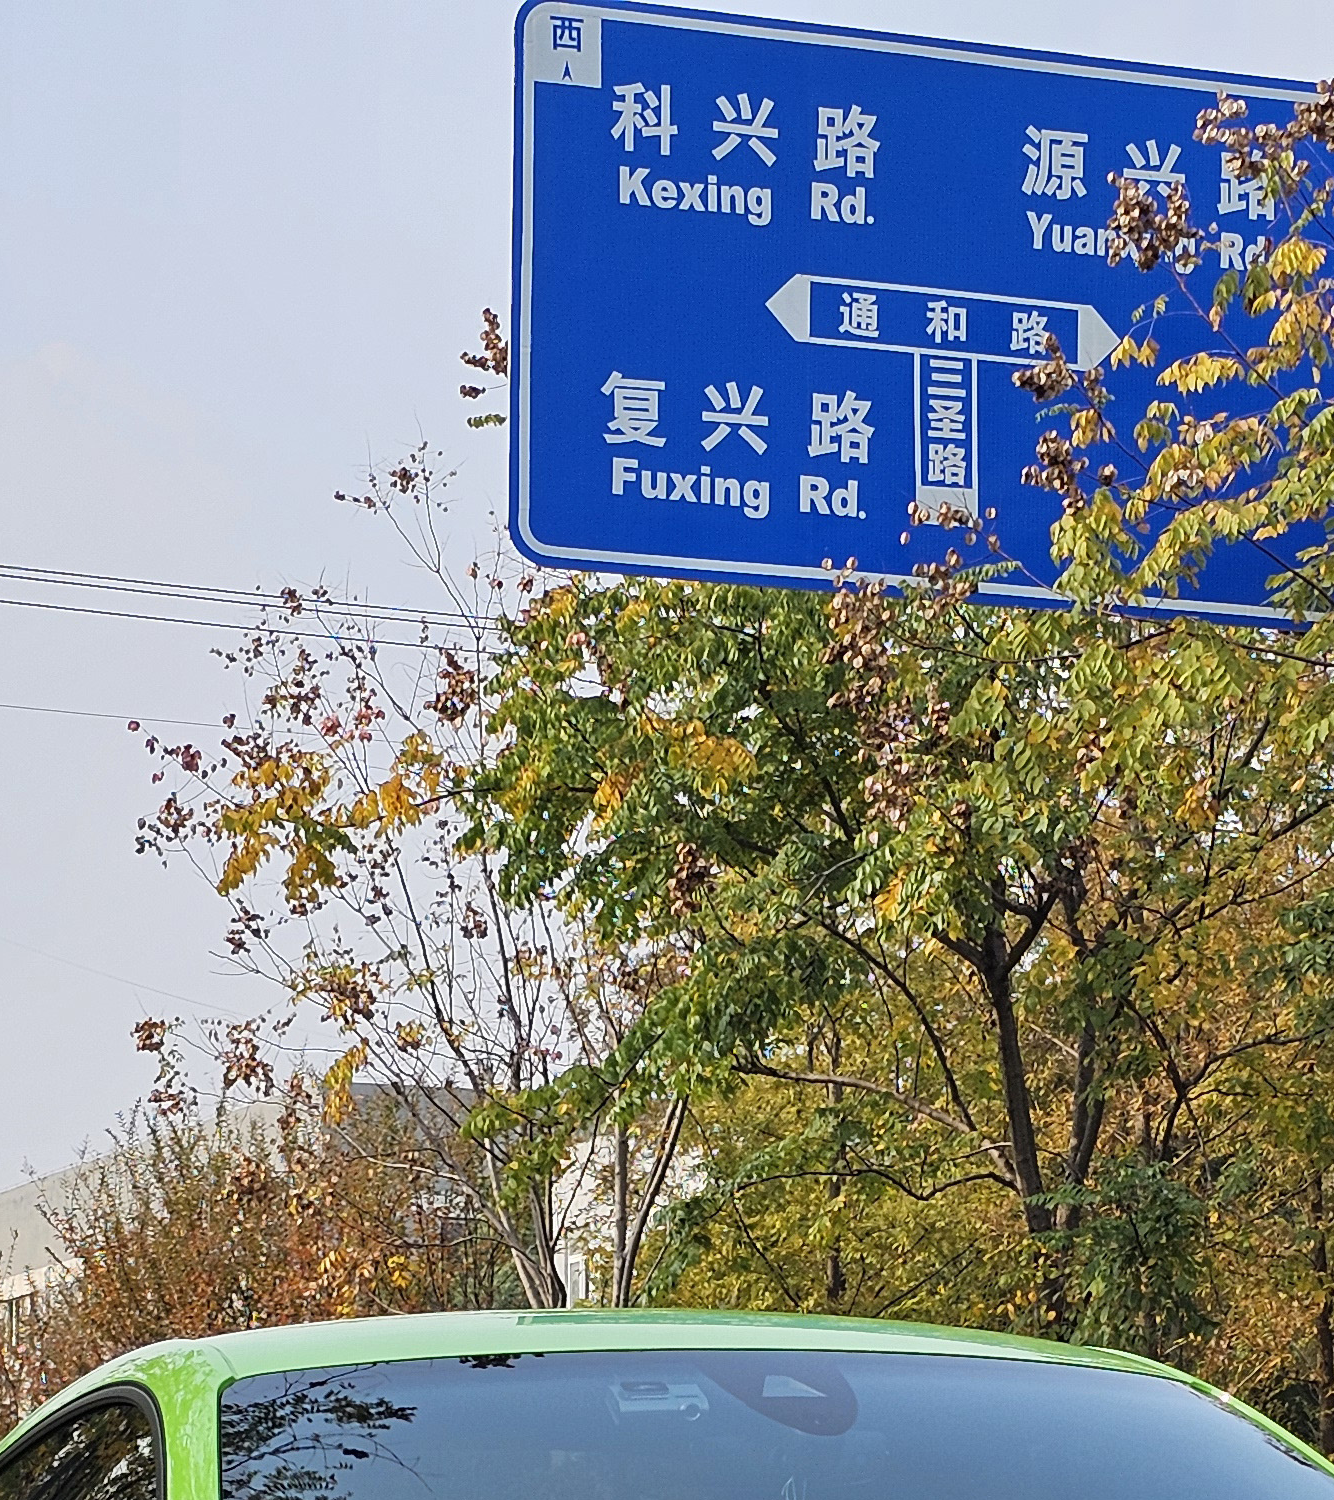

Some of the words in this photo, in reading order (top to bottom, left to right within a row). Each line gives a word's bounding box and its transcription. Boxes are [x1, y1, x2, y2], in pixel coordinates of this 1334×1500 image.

[550, 15, 584, 52] 西
[611, 82, 880, 178] 科兴路
[619, 166, 771, 225] Kexing
[811, 182, 874, 224] Rd.
[1022, 125, 1277, 221] 源兴路
[1027, 211, 1197, 275] Yuanxg
[839, 292, 1049, 355] 通和路
[601, 371, 875, 464] 复兴路
[927, 359, 967, 486] 三圣路
[611, 457, 770, 519] Fuxing
[799, 475, 867, 519] Rd.
